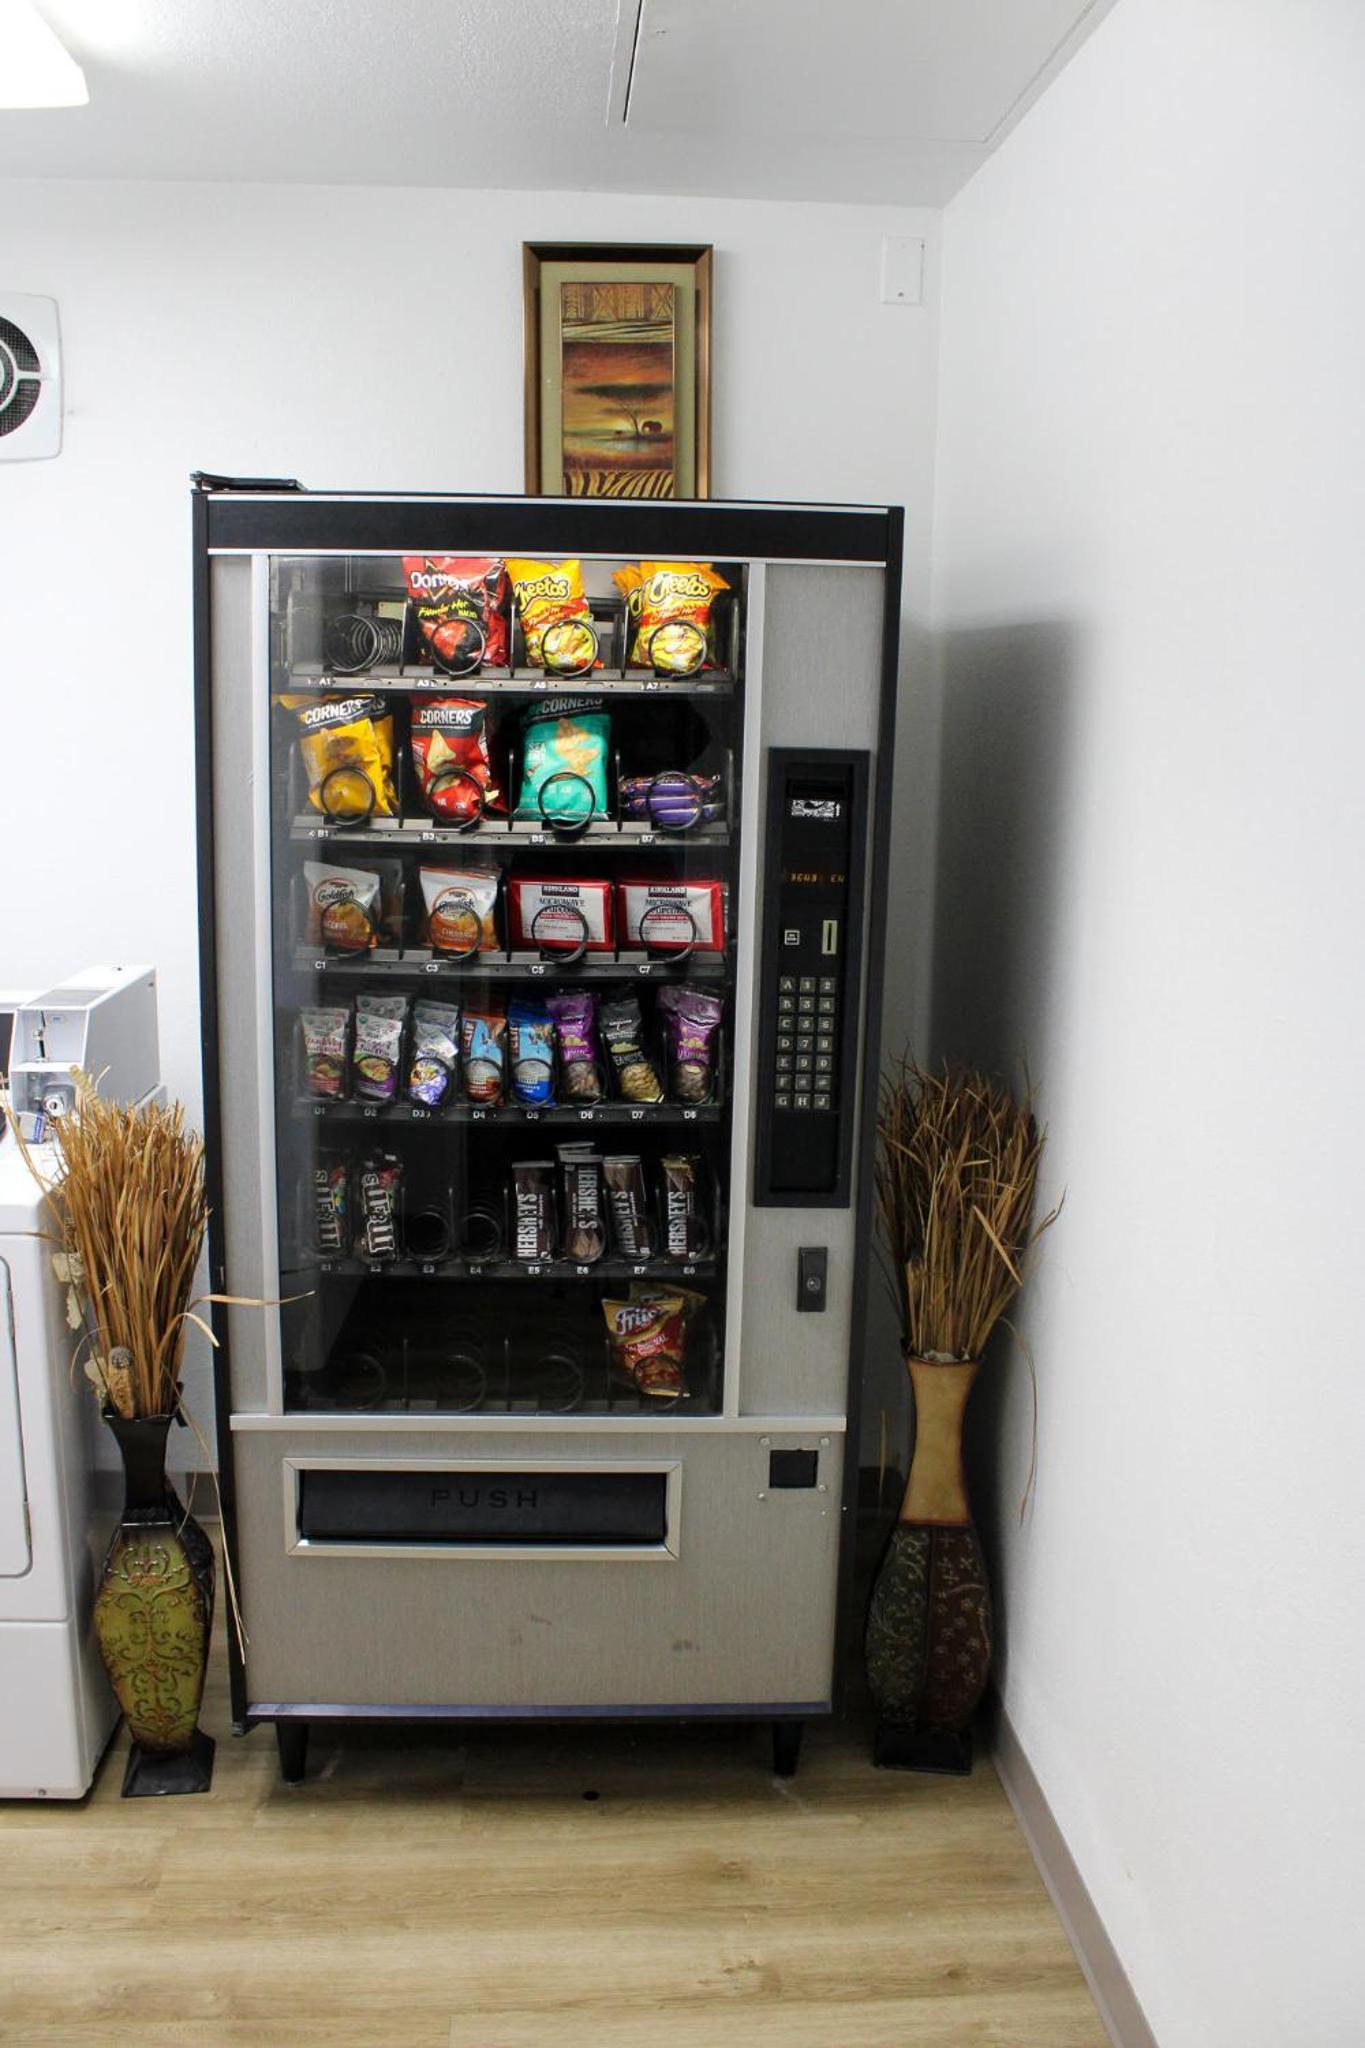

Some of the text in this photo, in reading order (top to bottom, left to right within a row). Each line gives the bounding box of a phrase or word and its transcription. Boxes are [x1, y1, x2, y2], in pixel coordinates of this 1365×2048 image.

[649, 571, 711, 603] Cheetos
[319, 678, 331, 686] A1
[646, 682, 659, 690] A7
[304, 698, 364, 725] CORNERS
[420, 709, 473, 724] CORNERS
[317, 829, 329, 837] B1
[422, 832, 435, 840] B3
[641, 834, 653, 843] B7
[317, 888, 354, 902] Goldfish
[315, 961, 327, 969] C1
[531, 966, 544, 974] C5
[639, 966, 651, 974] C7
[314, 1107, 325, 1116] D1
[364, 1107, 377, 1117] D2
[473, 1110, 486, 1119] D4
[580, 1110, 594, 1119] D6
[632, 1110, 644, 1119] D7
[528, 1266, 541, 1275] E5
[576, 1266, 590, 1275] E6
[634, 1266, 647, 1275] E7
[430, 1488, 538, 1509] PUSH
